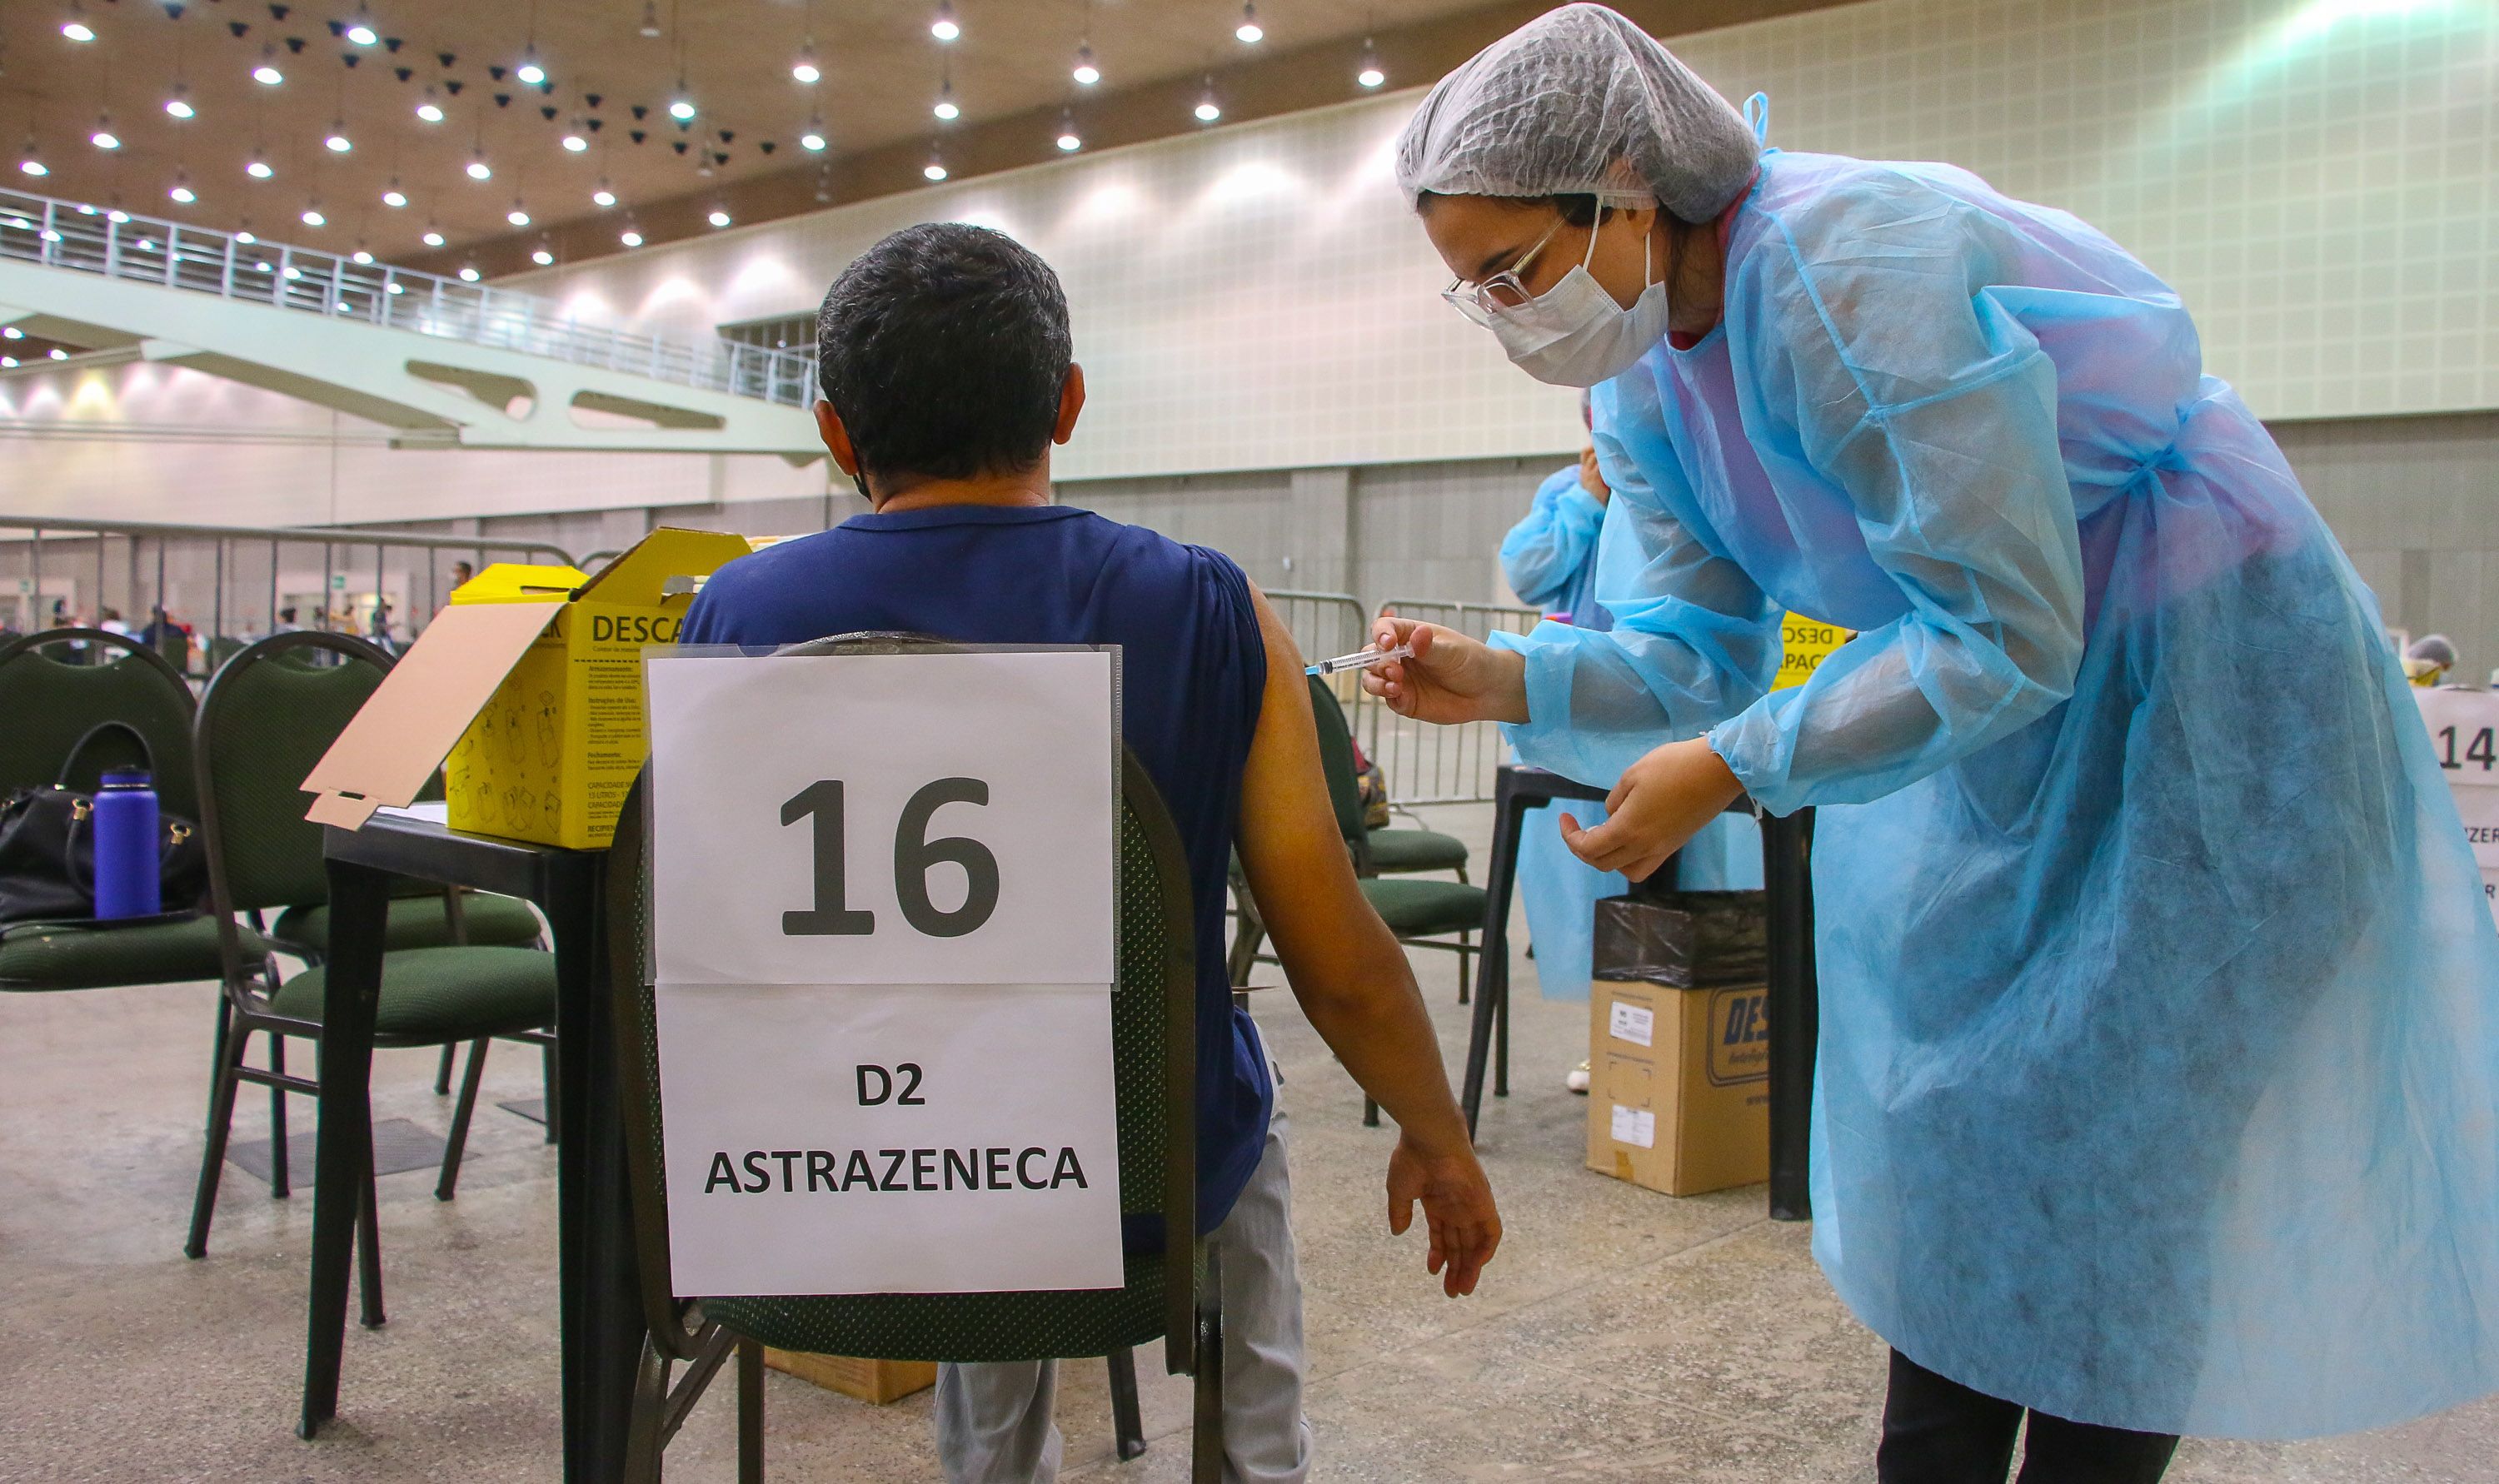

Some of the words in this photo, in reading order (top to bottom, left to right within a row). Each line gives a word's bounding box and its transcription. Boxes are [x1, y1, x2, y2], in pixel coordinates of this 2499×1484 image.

[1781, 654, 1826, 670] PAC
[2439, 726, 2497, 771] 14
[2464, 827, 2499, 843] ZER
[781, 777, 1000, 938] 16
[856, 1063, 925, 1106] D2
[705, 1147, 1088, 1194] ASTRAZENECA
